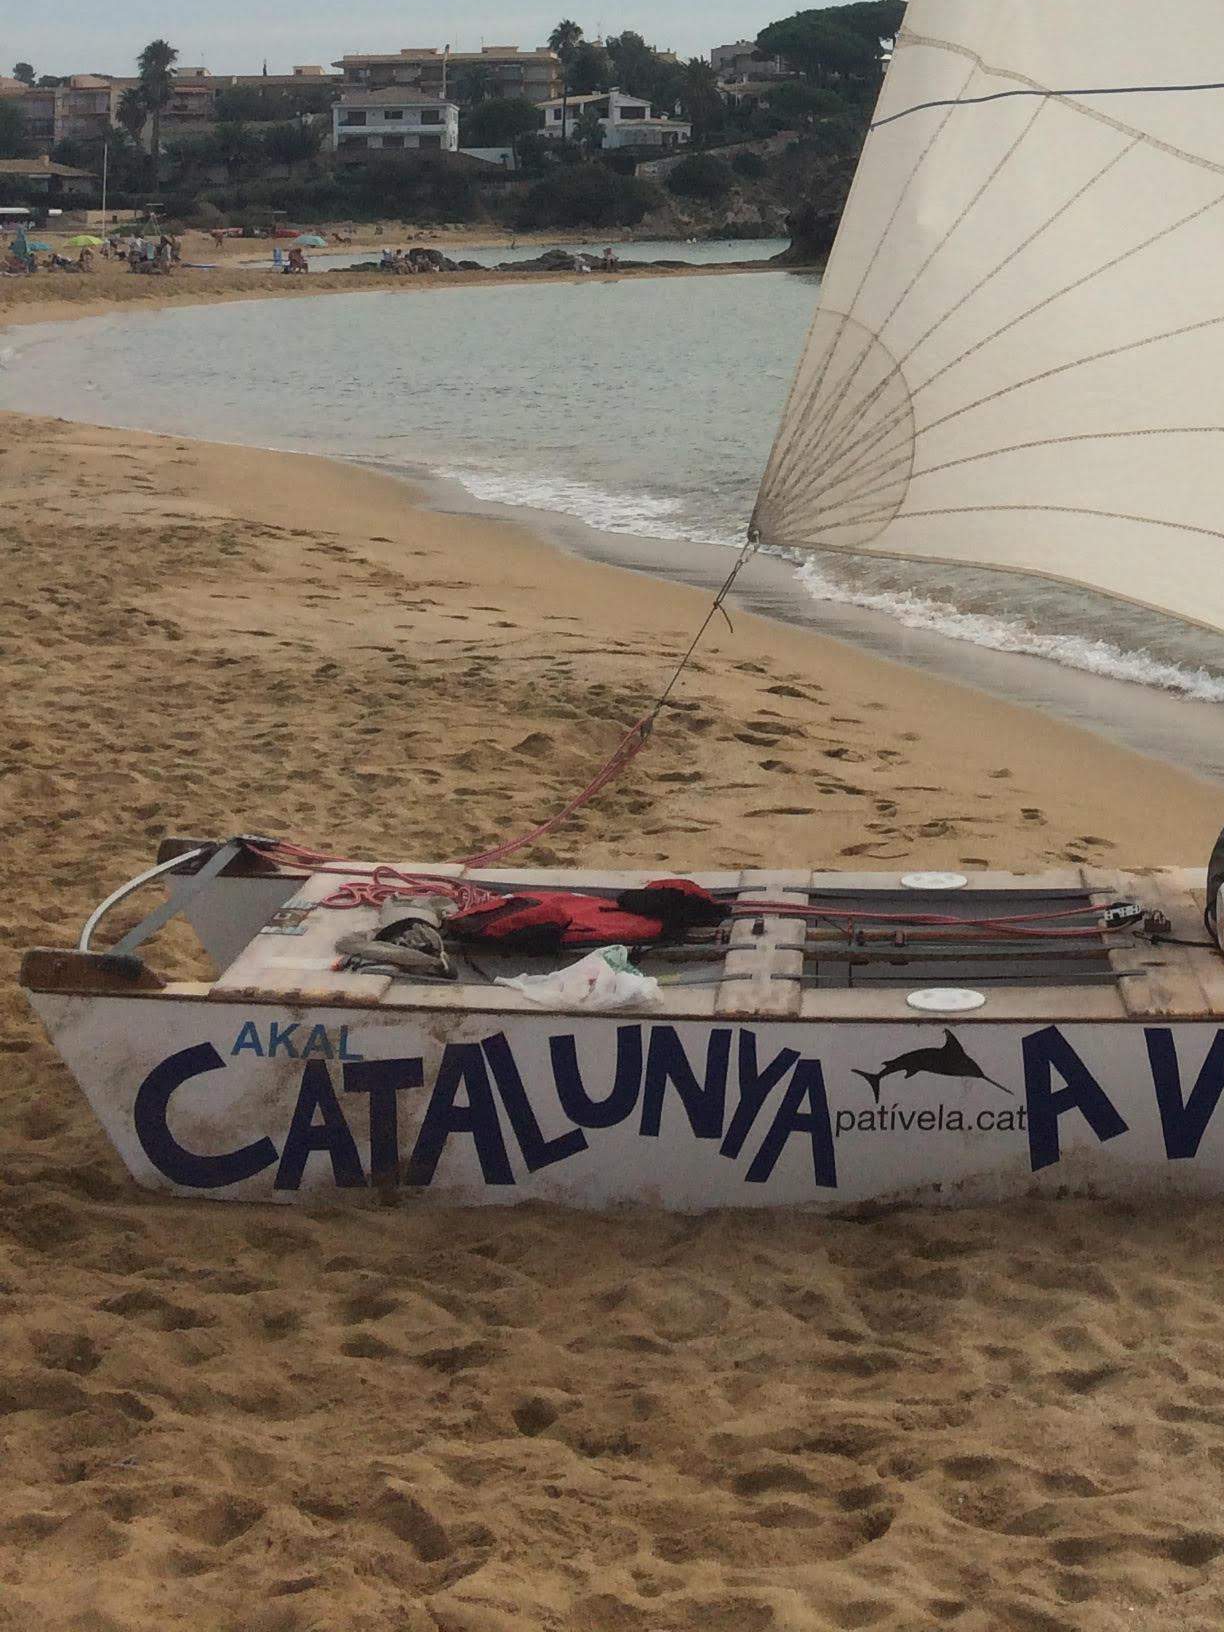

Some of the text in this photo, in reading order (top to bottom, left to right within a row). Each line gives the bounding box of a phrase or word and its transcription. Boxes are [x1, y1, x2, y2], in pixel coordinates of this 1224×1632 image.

[231, 1021, 364, 1061] AKAL
[134, 1024, 838, 1190] CATALUNYA
[1022, 1024, 1129, 1173] A
[835, 1103, 1028, 1138] patívela.cat
